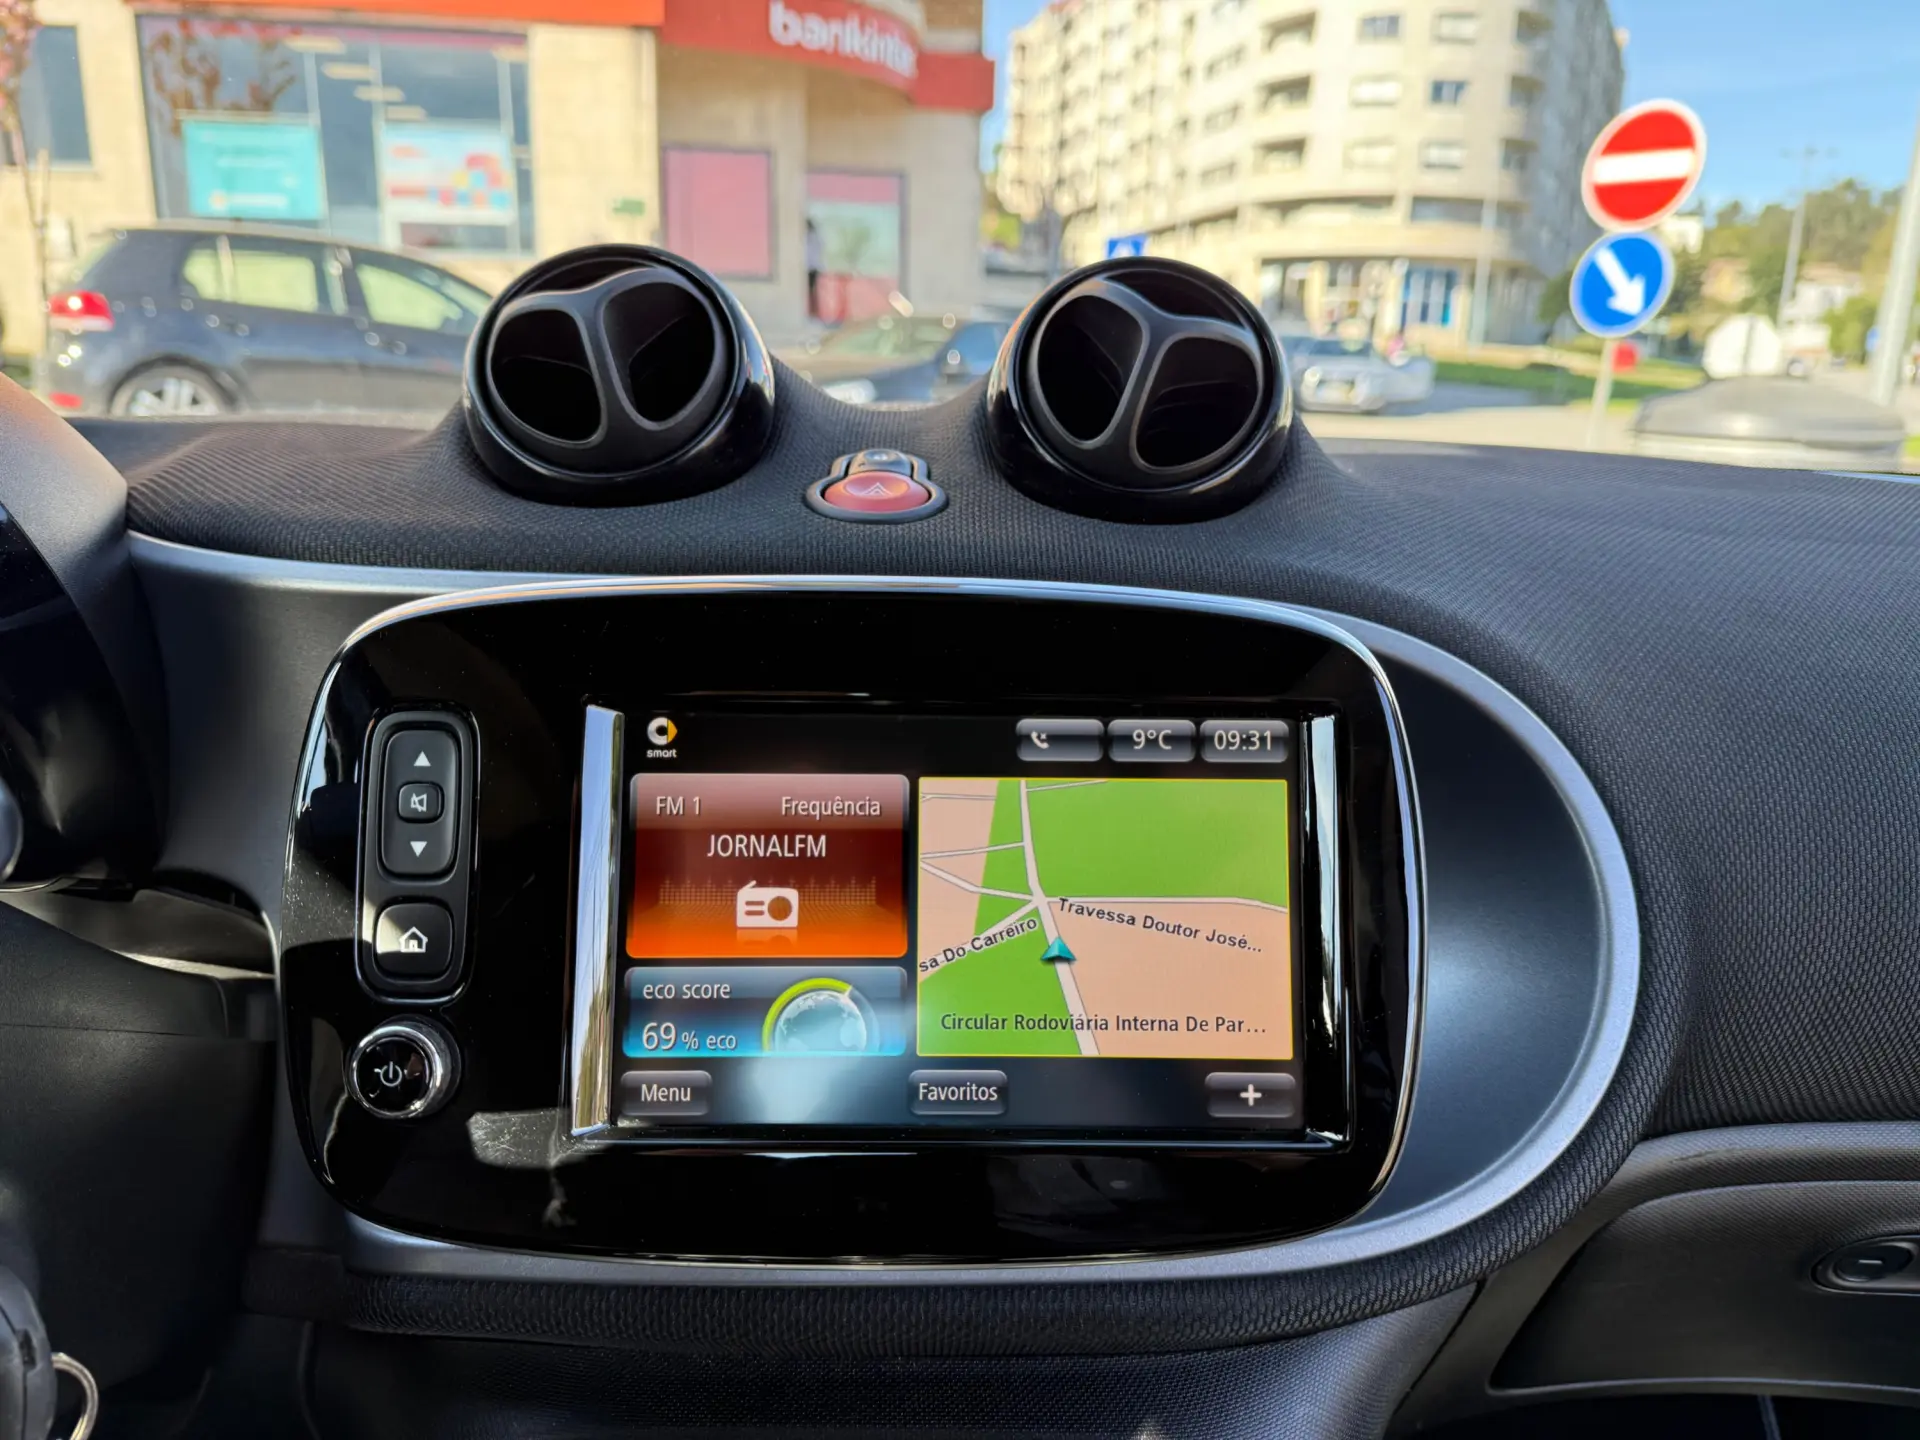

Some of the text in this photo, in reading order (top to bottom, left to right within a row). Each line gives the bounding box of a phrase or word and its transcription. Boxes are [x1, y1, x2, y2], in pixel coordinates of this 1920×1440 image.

[1132, 729, 1172, 751] 9°C
[1213, 730, 1273, 751] 09:31
[647, 747, 677, 759] smart
[656, 796, 701, 815] FM 1
[781, 795, 882, 820] Frequência
[707, 834, 827, 857] JORNALFM
[1058, 897, 1137, 927] Travessa
[1142, 915, 1201, 940] Doutor
[942, 945, 967, 963] Do
[970, 917, 1038, 953] Carreiro
[643, 982, 731, 1000] eco score
[940, 1013, 1008, 1031] Circular
[1014, 1013, 1110, 1032] Rodoviária
[1115, 1014, 1180, 1033] Interna
[1185, 1016, 1210, 1033] De
[642, 1022, 737, 1050] 69 % eco
[641, 1083, 691, 1102] Menu
[918, 1082, 998, 1102] Favoritos
